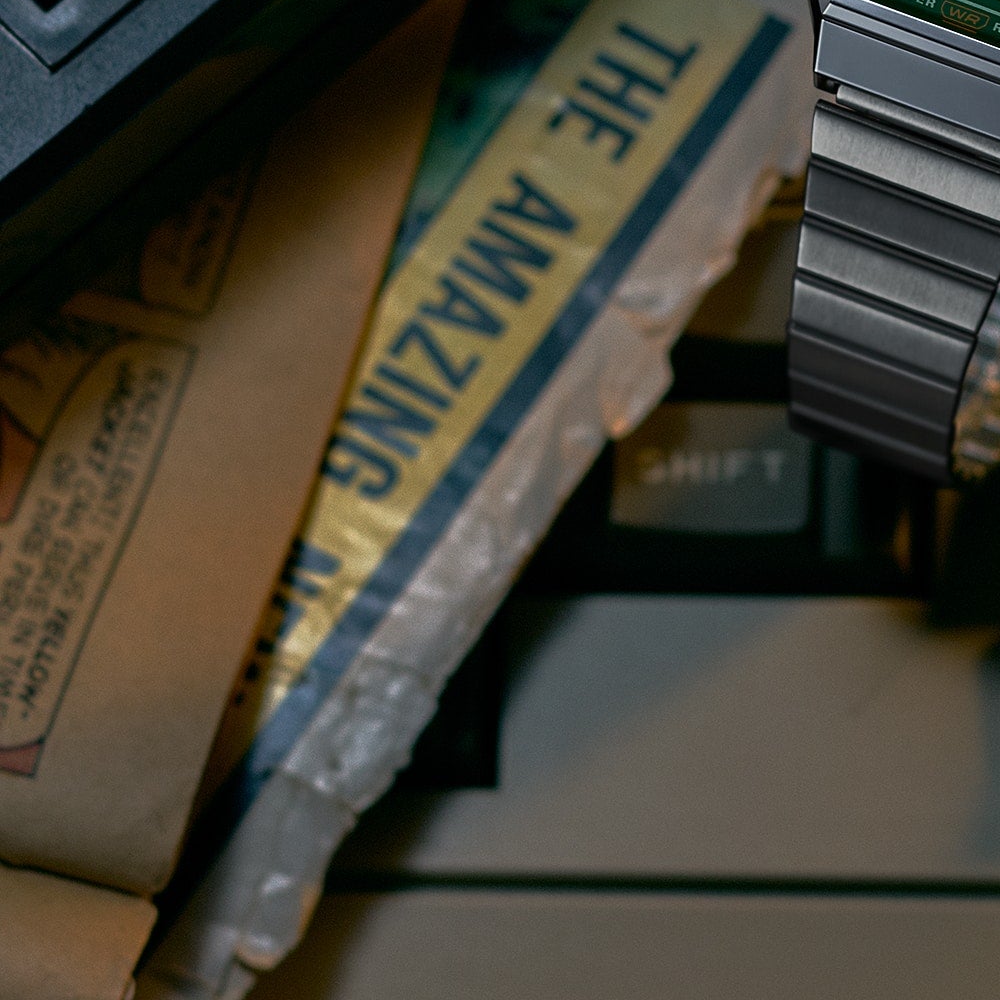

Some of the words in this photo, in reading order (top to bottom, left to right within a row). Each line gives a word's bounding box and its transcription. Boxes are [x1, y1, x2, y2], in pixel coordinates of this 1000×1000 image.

[948, 7, 982, 26] WR
[550, 21, 698, 167] THE
[320, 171, 579, 498] AMAZING
